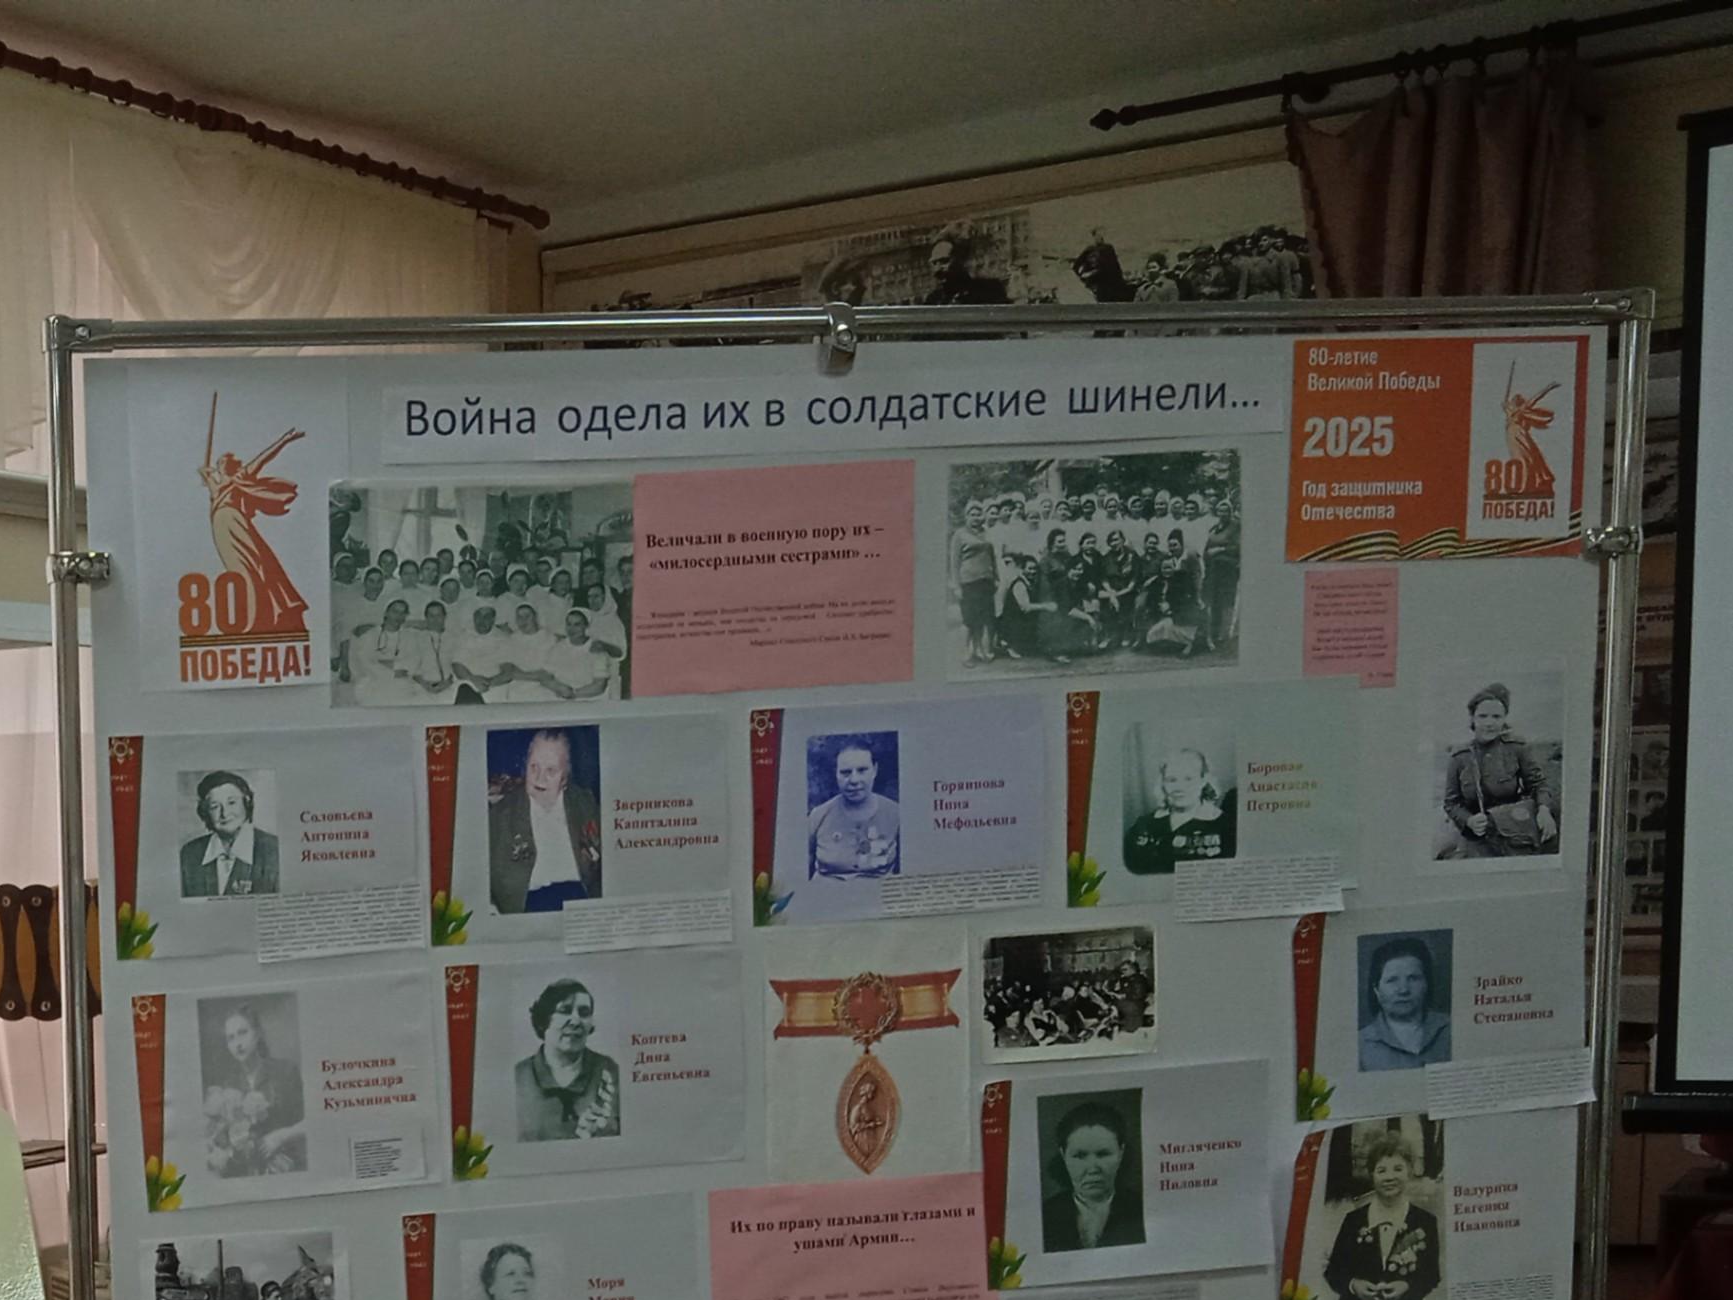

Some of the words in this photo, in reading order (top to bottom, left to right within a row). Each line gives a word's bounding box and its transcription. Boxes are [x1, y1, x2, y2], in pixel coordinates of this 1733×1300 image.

[1308, 347, 1378, 366] 80-летие
[1308, 372, 1373, 392] Великой
[1378, 371, 1441, 391] Победы
[406, 397, 536, 437] Война
[558, 402, 687, 441] одела
[704, 400, 751, 428] их
[765, 399, 786, 427] в
[806, 388, 1047, 431] солдатские
[1068, 381, 1260, 414] шинели...
[1302, 416, 1395, 458] 2025
[1484, 458, 1527, 494] 80
[1302, 479, 1326, 497] Год
[1331, 479, 1423, 497] защитника
[1301, 503, 1396, 521] Отечества
[1482, 499, 1555, 521] ПОБЕДА!
[645, 532, 723, 549] Величали
[740, 528, 808, 544] военную
[811, 525, 848, 541] пору
[852, 523, 871, 537] их
[649, 554, 776, 571] «милосердными
[780, 548, 860, 565] сестрами»
[178, 572, 248, 635] 80
[180, 645, 311, 683] ПОБЕДА!
[932, 799, 970, 811] Нина
[613, 814, 698, 831] Капиталина
[300, 830, 371, 844] Антонина
[614, 833, 720, 850] Александровна
[300, 847, 377, 863] Яковлевна
[1474, 992, 1533, 1006] Наталья
[1473, 1008, 1554, 1025] Степановна
[634, 1051, 672, 1066] Дина
[322, 1074, 404, 1092] Александра
[632, 1068, 711, 1083] Евгеньевна
[323, 1092, 417, 1112] Кузьминична
[1159, 1160, 1195, 1174] Нина
[730, 1220, 753, 1234] Их
[756, 1221, 775, 1233] по
[778, 1217, 822, 1234] праву
[826, 1212, 898, 1229] называли
[902, 1207, 961, 1224] глазами
[964, 1206, 976, 1217] и
[1453, 1217, 1521, 1233] Ивановна
[793, 1237, 846, 1254] ушами
